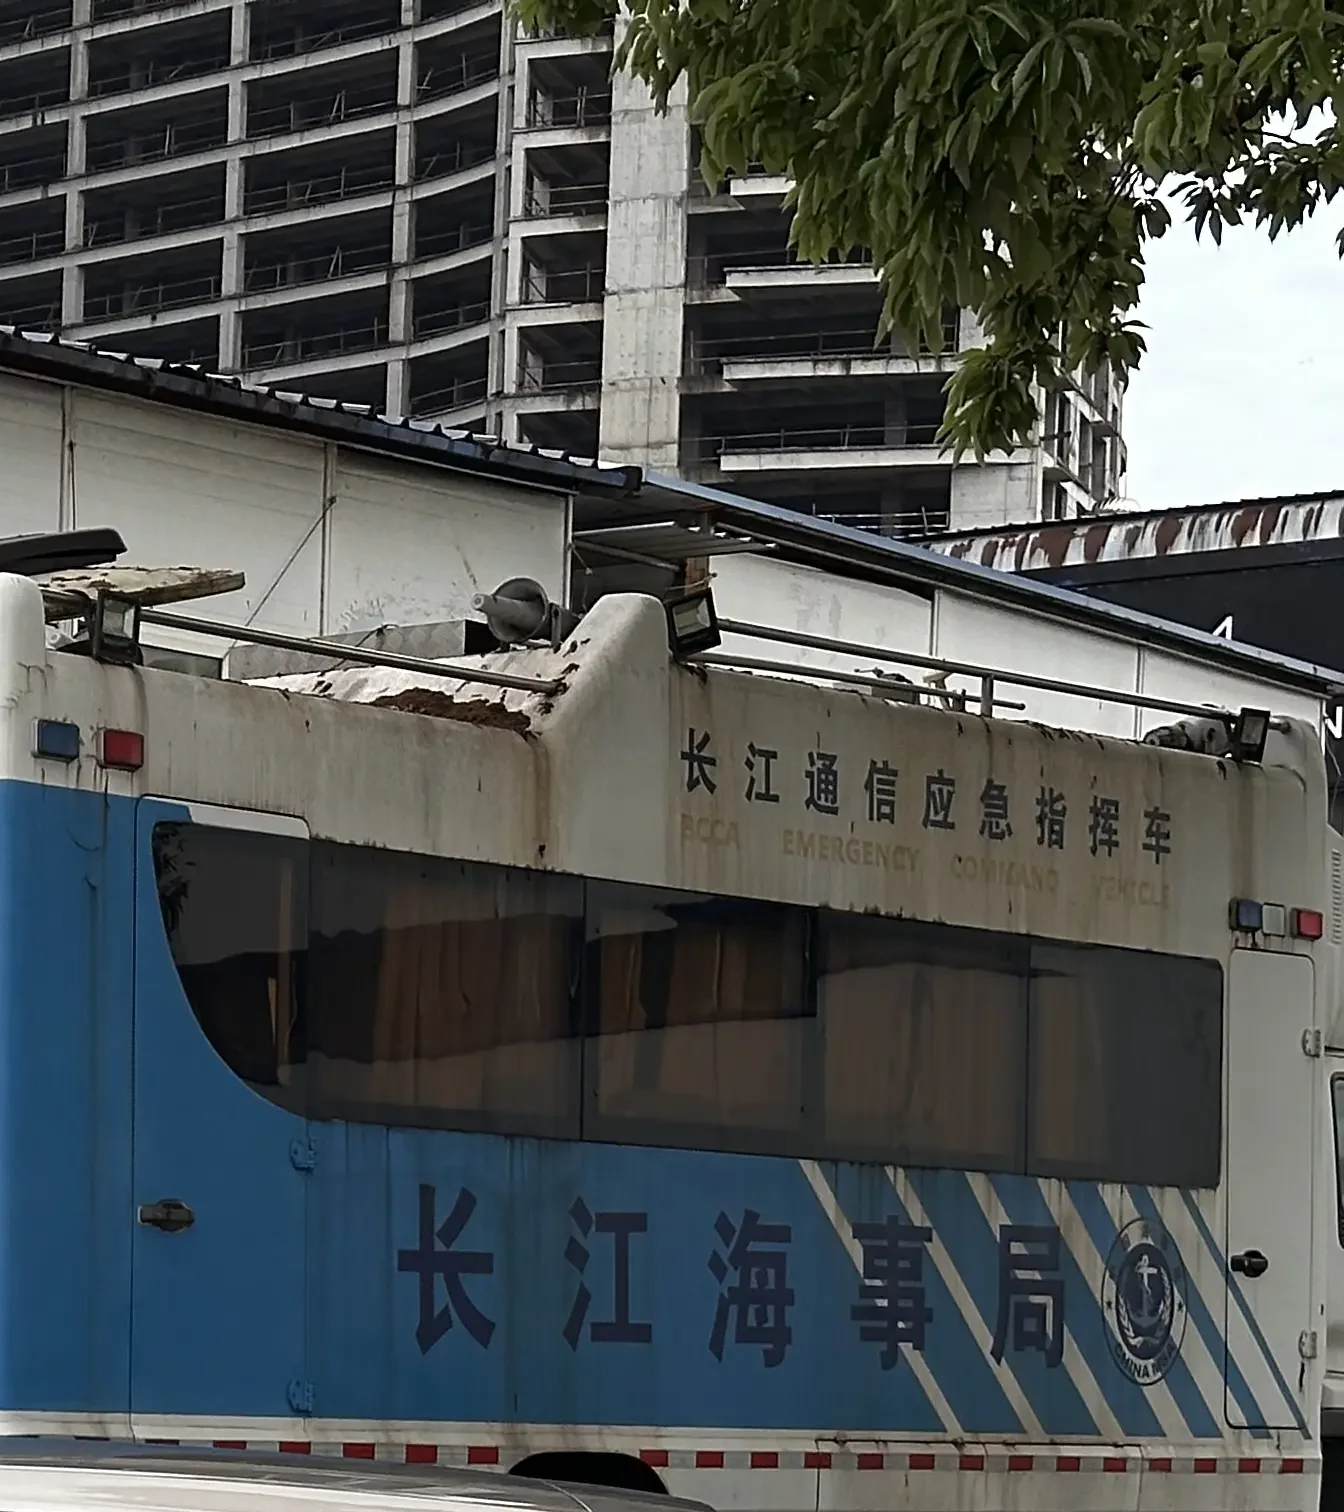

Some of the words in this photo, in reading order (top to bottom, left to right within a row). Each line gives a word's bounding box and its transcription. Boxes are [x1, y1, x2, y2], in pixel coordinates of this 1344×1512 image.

[680, 727, 1172, 864] 长江通信应急指挥车
[782, 828, 921, 873] EMERGENCY
[397, 1182, 1066, 1370] 长江海事局
